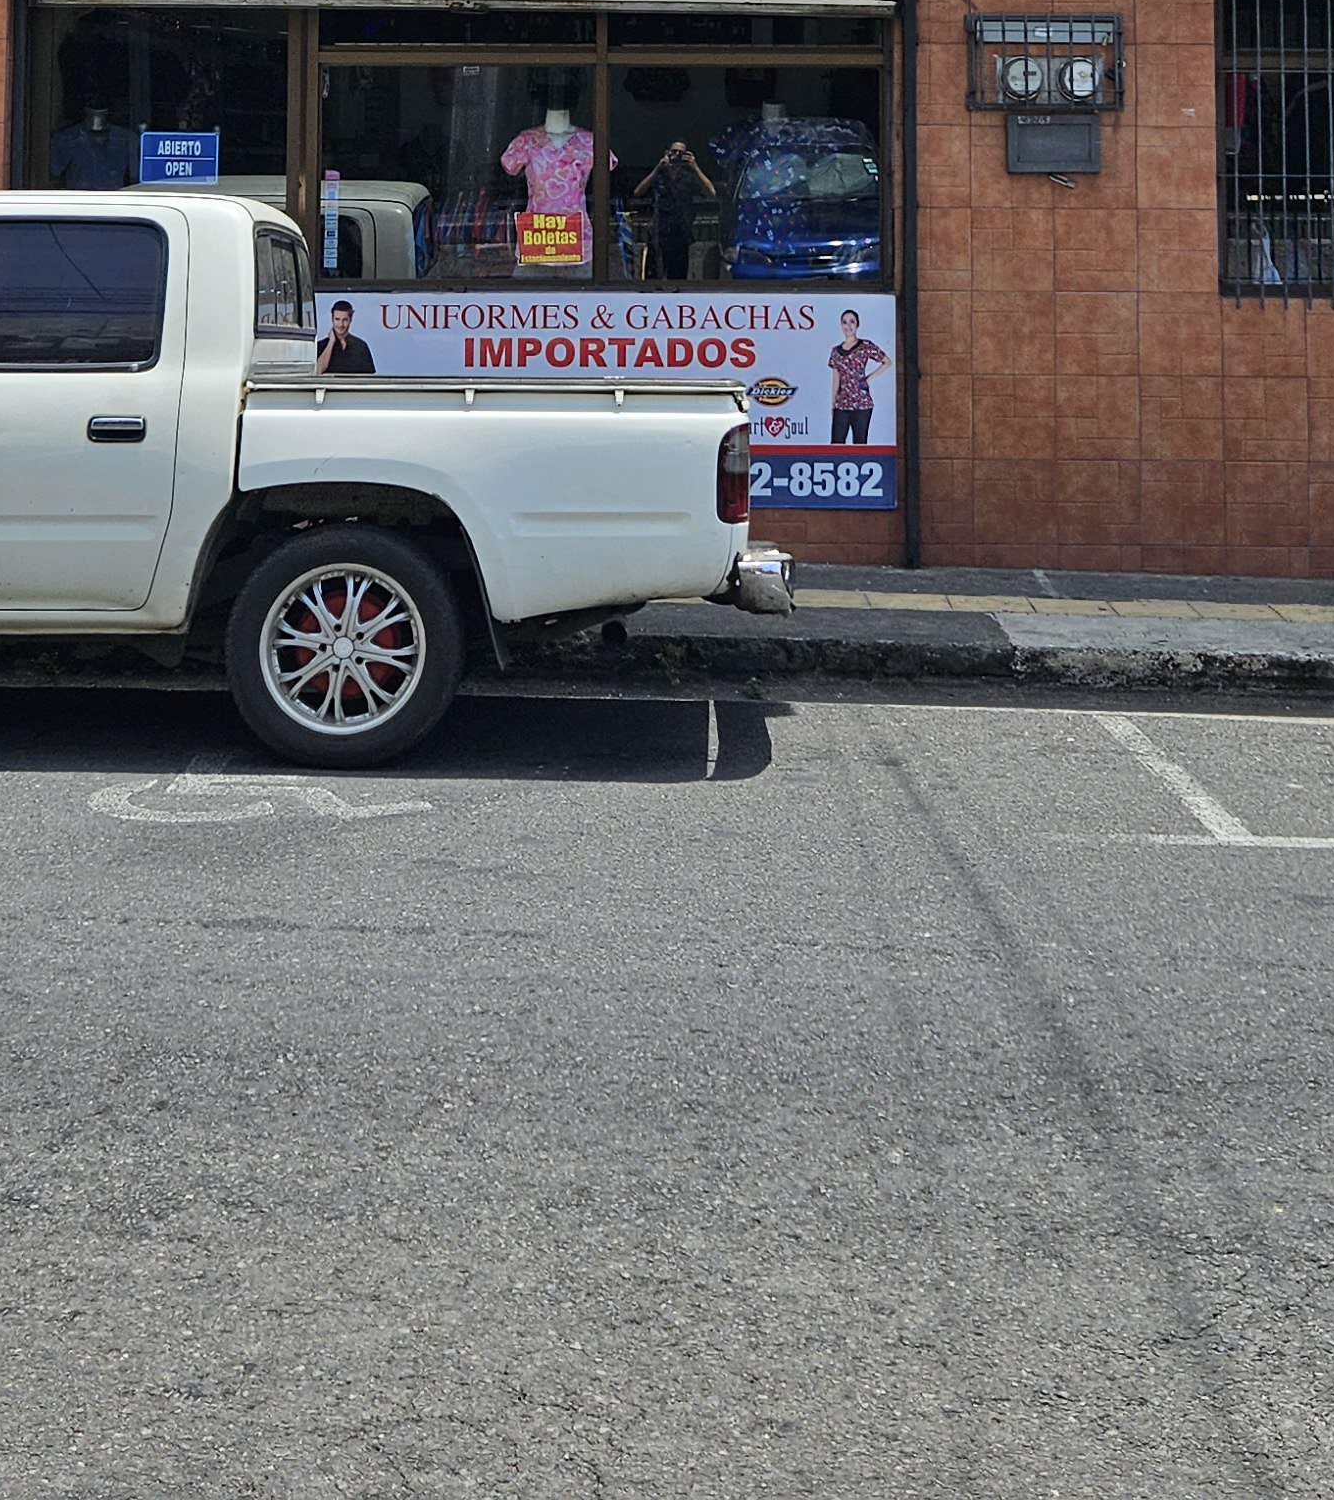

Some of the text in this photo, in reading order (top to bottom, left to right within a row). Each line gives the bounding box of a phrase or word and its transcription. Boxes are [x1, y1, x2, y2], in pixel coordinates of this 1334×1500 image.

[157, 140, 201, 156] ABIERTO
[165, 161, 193, 176] OPEN
[533, 214, 567, 230] Hay
[523, 230, 578, 245] Boletas
[379, 304, 815, 330] UNIFORMES & GABACHAS
[464, 337, 756, 369] IMPORTADOS
[750, 386, 793, 396] Dickies
[784, 416, 809, 439] Soul
[749, 461, 884, 497] 2-8582
